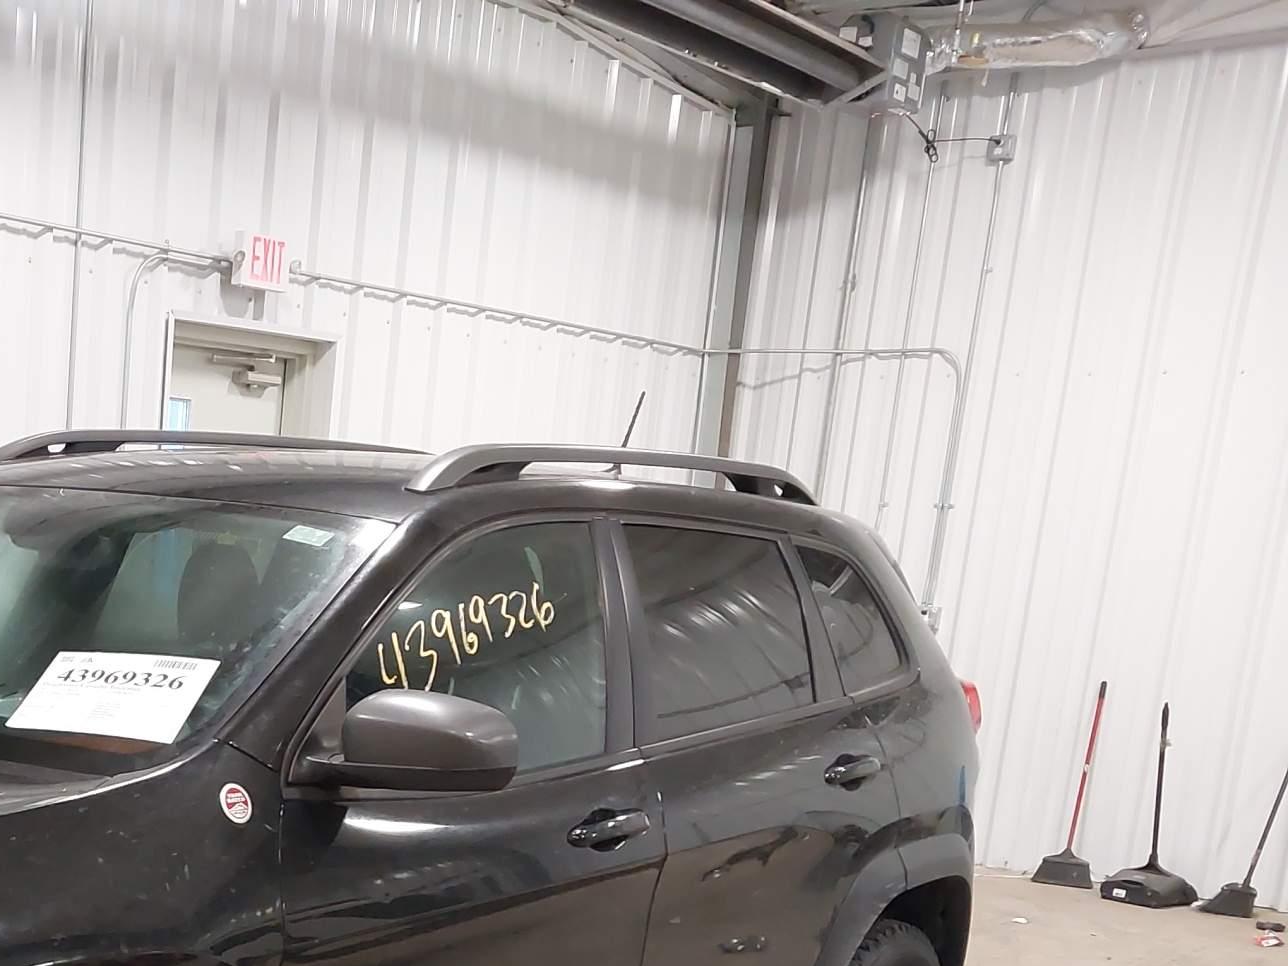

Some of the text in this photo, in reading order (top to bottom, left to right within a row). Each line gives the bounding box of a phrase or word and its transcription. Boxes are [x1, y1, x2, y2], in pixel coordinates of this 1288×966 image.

[249, 236, 285, 284] EXIT
[377, 582, 555, 691] 43969326
[57, 668, 186, 690] 43969326
